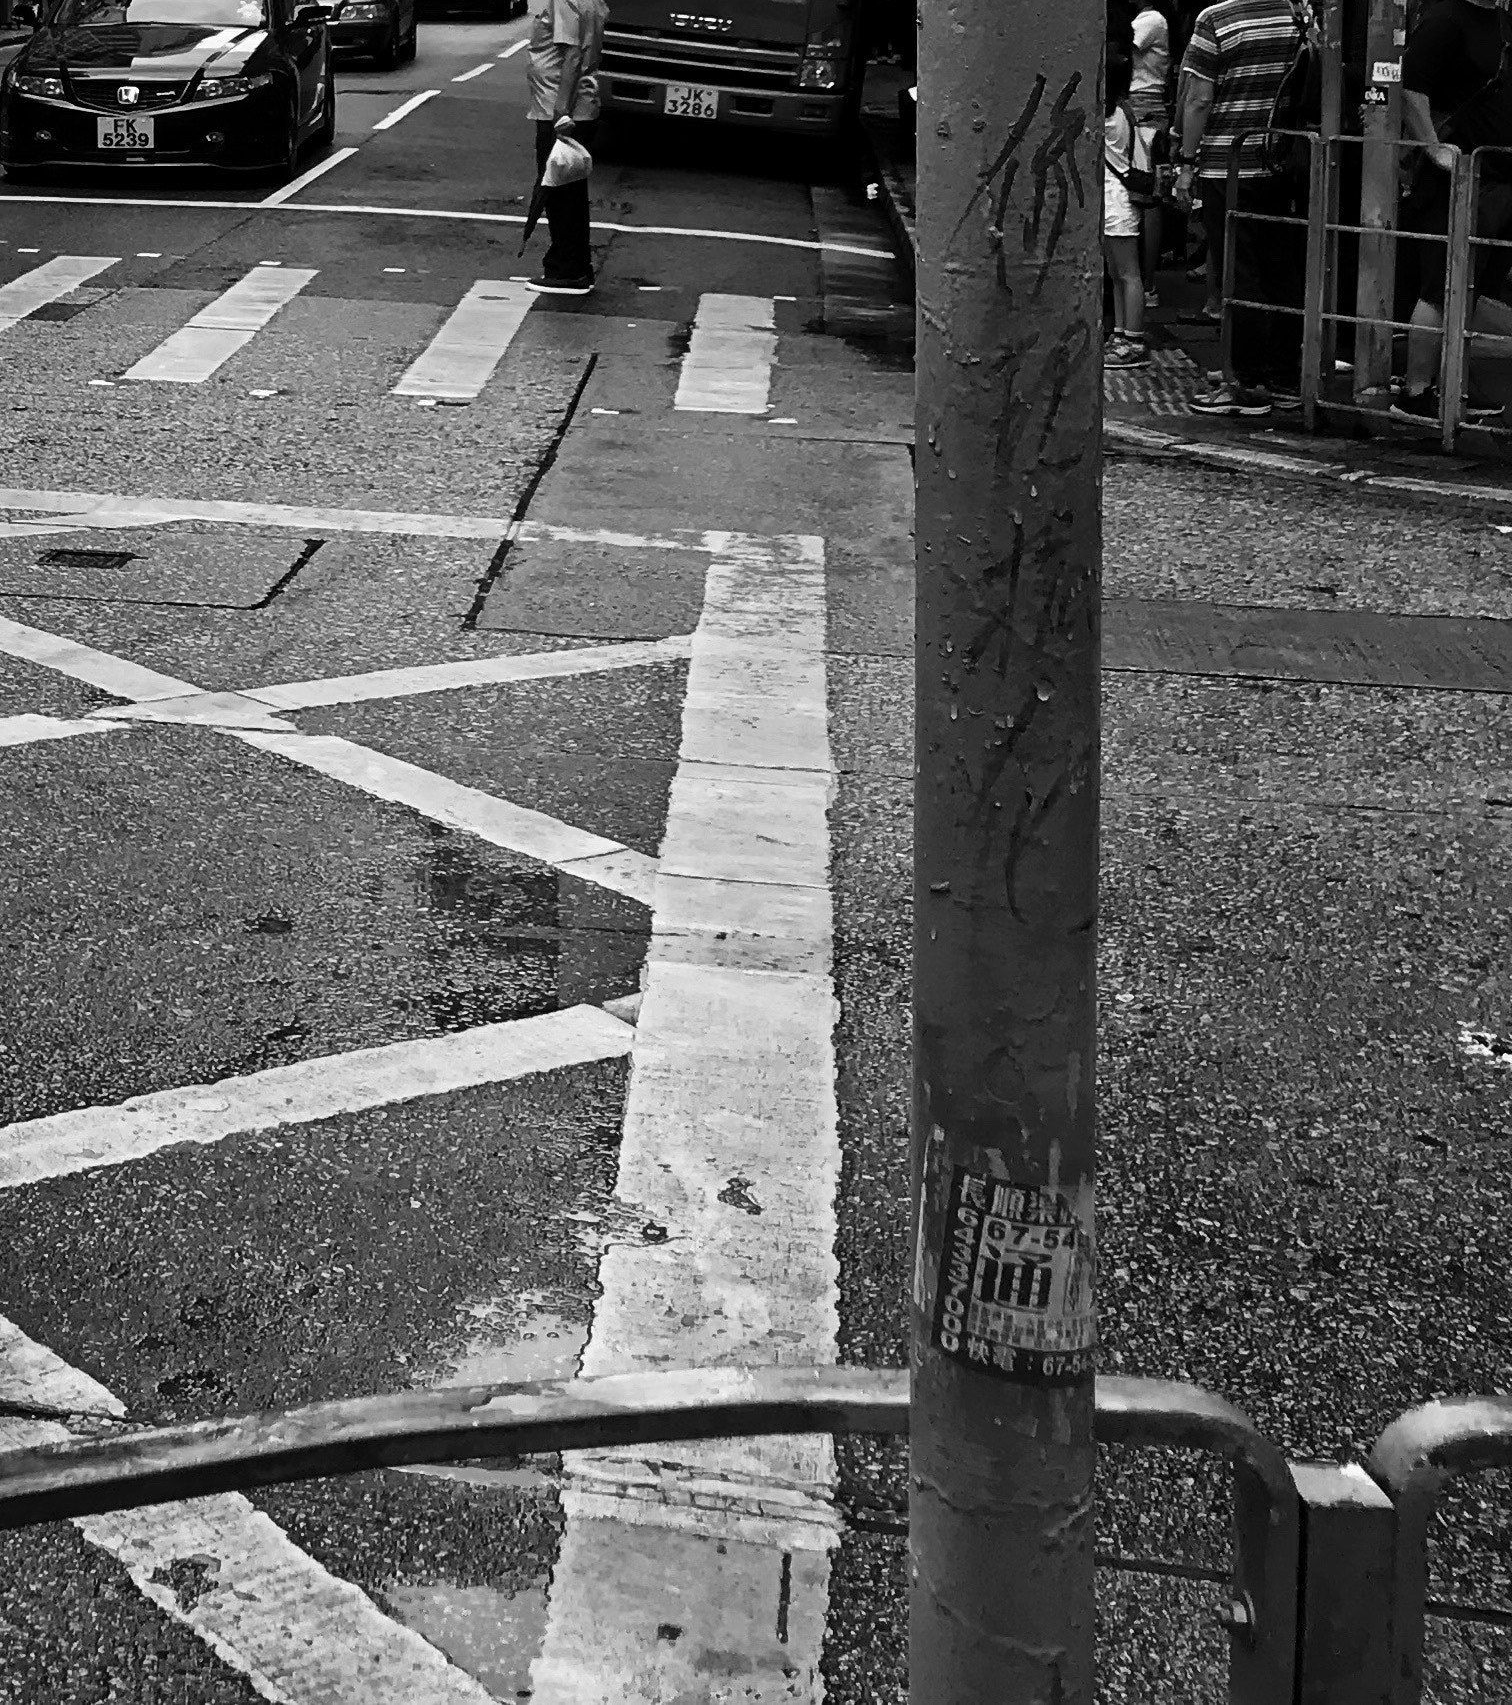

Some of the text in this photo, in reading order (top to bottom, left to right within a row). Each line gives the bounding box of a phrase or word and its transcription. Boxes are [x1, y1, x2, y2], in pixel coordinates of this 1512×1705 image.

[680, 87, 704, 103] JK
[667, 98, 716, 118] 3286
[113, 118, 138, 134] FK
[101, 132, 150, 148] 5239
